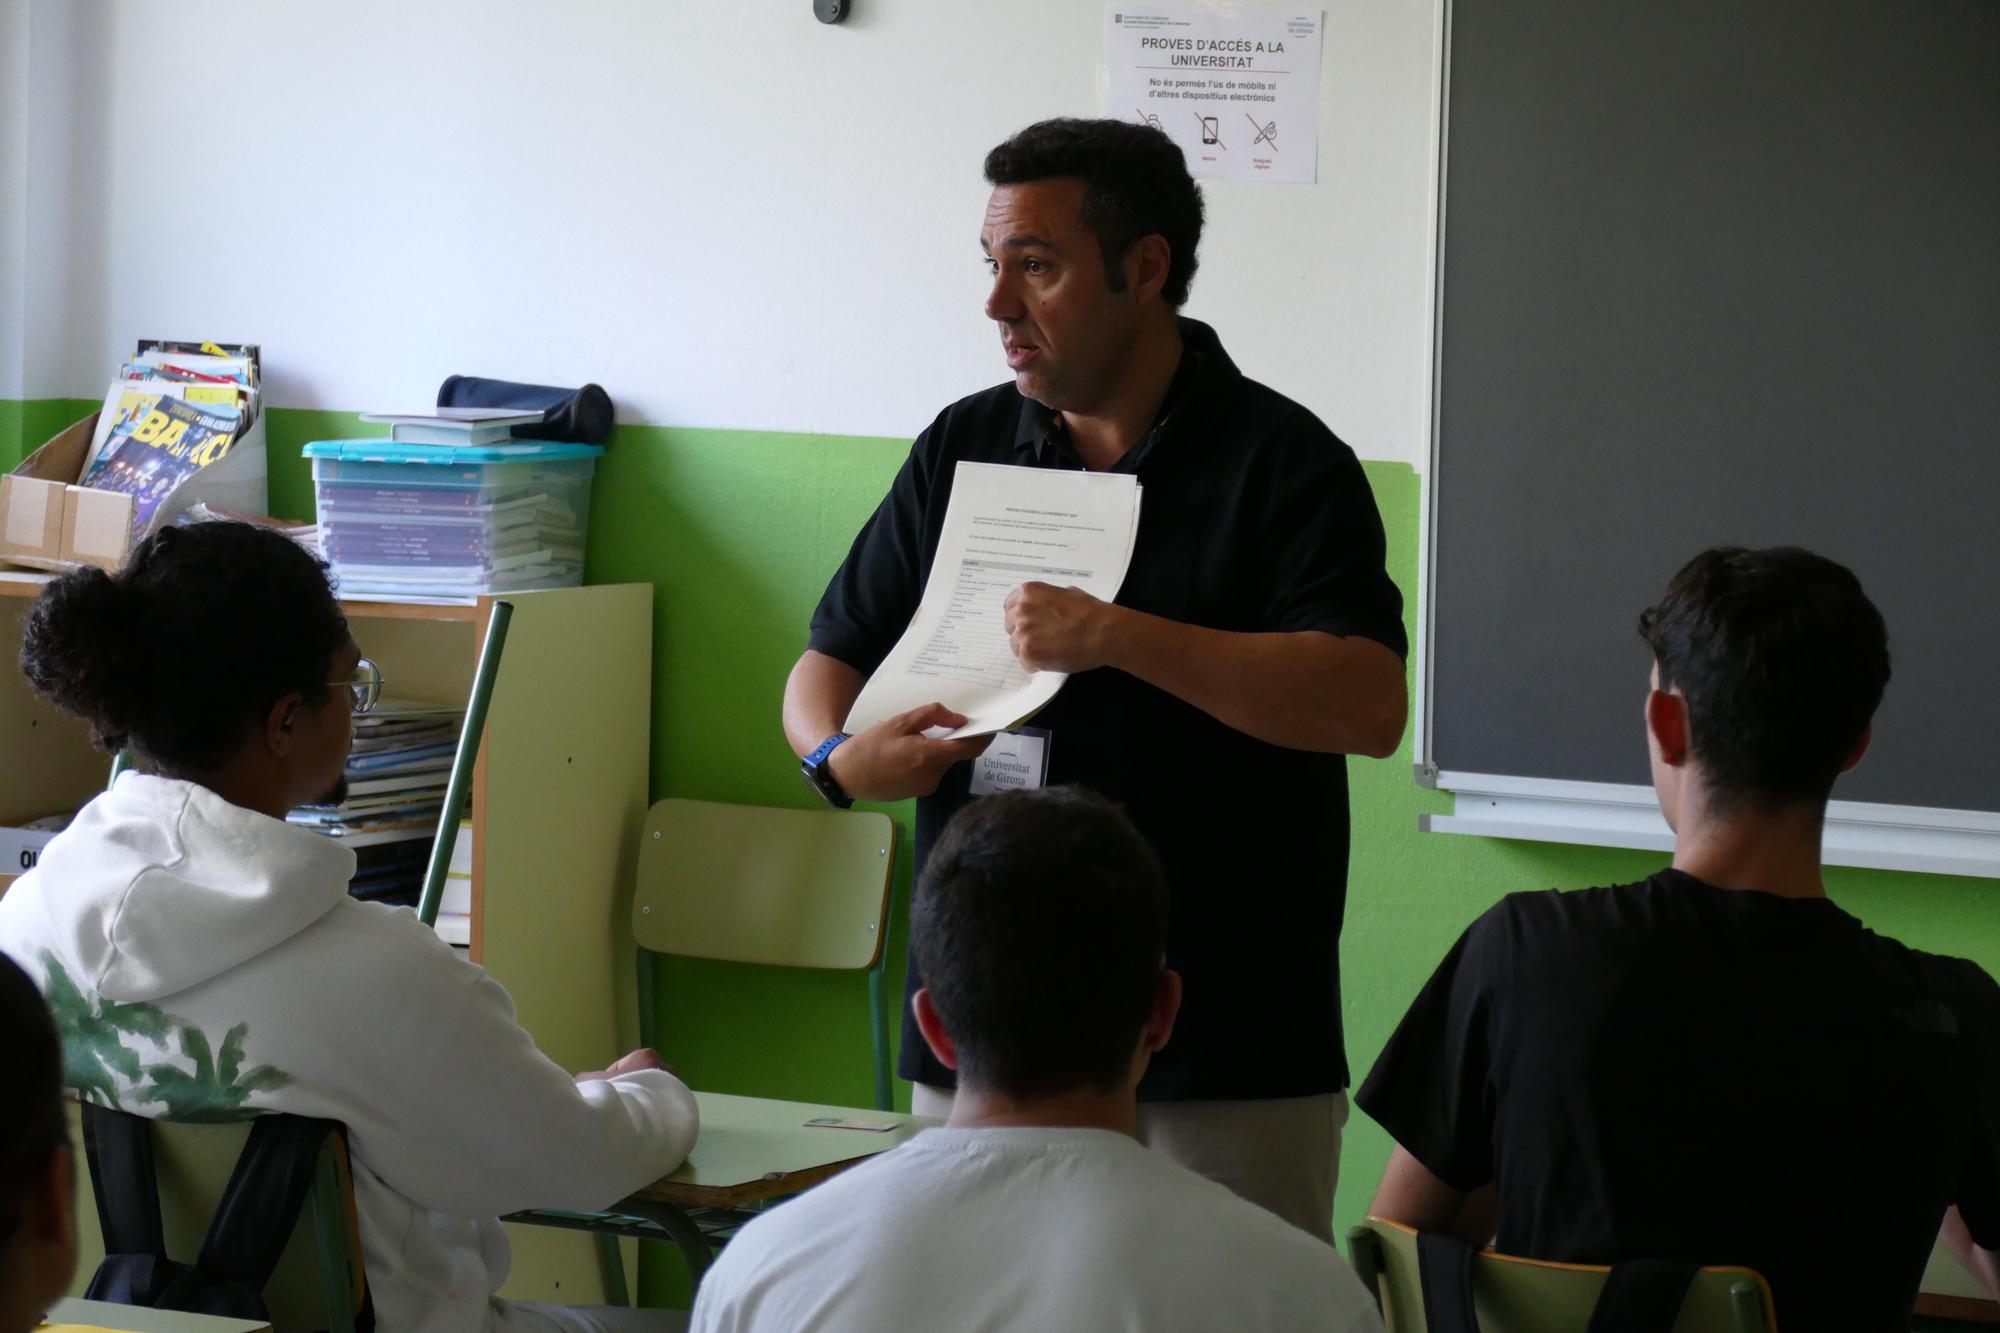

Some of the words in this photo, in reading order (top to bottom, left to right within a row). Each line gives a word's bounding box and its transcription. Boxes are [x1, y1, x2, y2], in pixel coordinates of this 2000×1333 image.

[1141, 37, 1193, 50] PROVES
[1196, 38, 1252, 52] D'ACCÉS
[1255, 41, 1265, 53] A
[1268, 42, 1285, 53] LA
[1171, 54, 1254, 68] UNIVERSITAT
[1149, 78, 1161, 87] No
[1225, 80, 1236, 89] de
[1268, 82, 1276, 91] ni
[1149, 90, 1180, 99] d'altres
[1182, 91, 1228, 101] dispositius
[984, 758, 1030, 774] Universitat
[984, 770, 996, 781] de
[996, 772, 1026, 786] Girona
